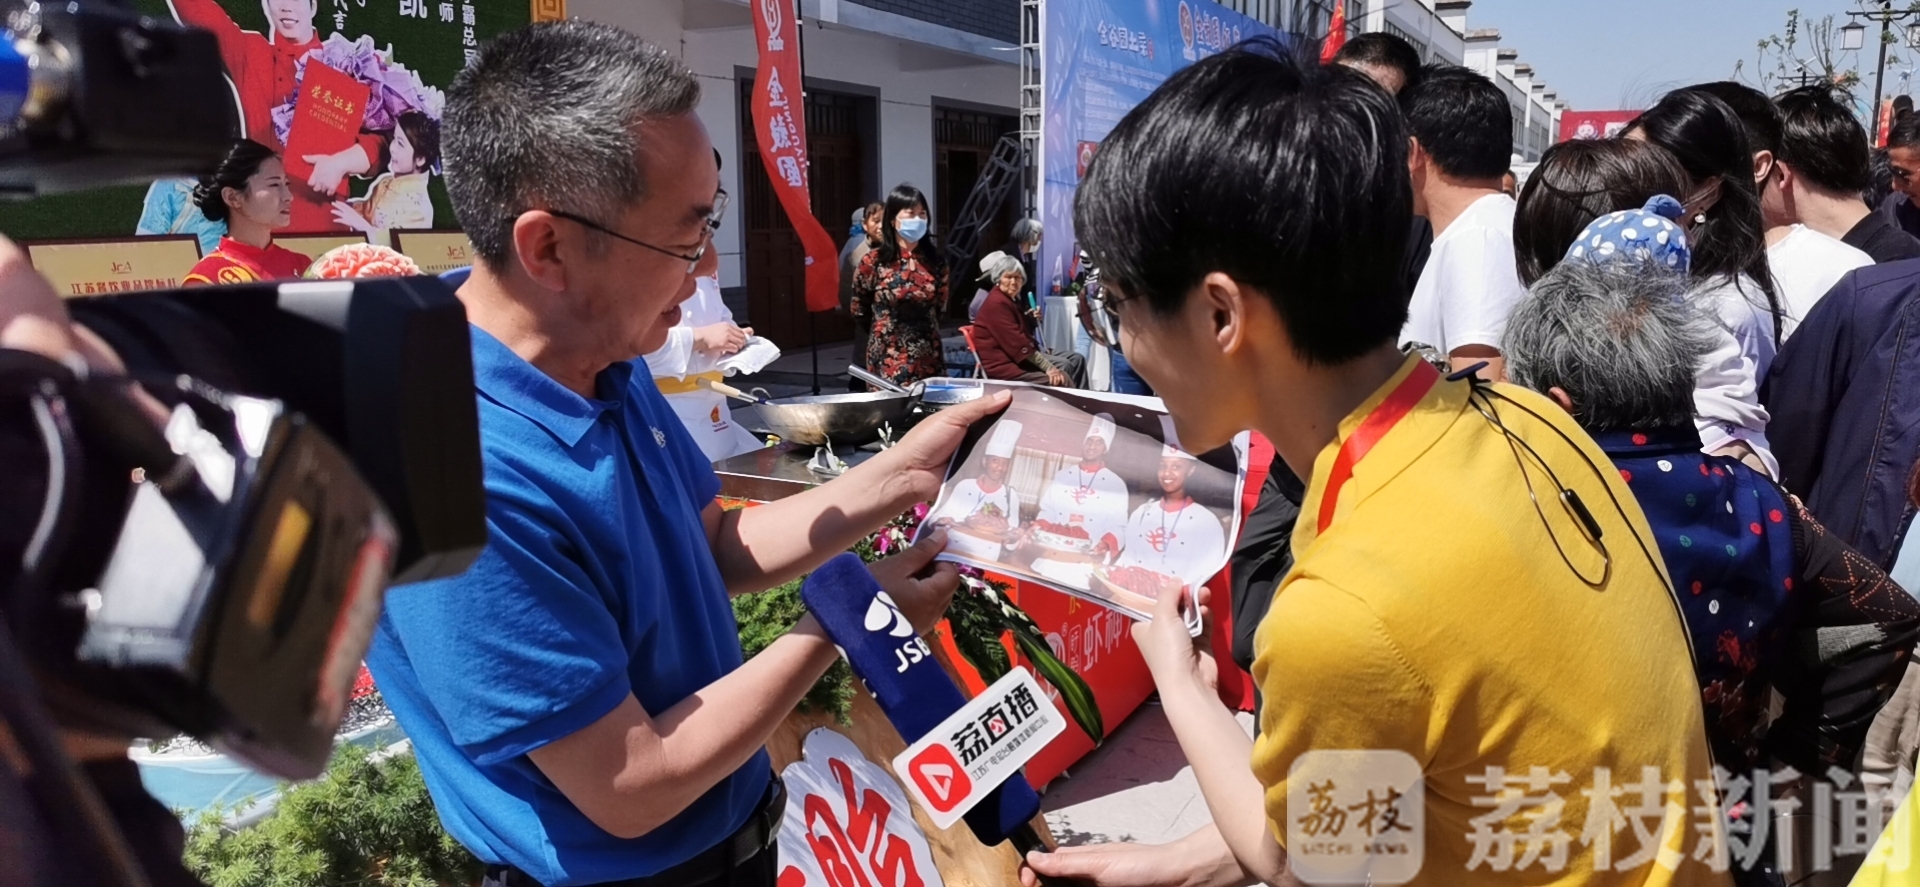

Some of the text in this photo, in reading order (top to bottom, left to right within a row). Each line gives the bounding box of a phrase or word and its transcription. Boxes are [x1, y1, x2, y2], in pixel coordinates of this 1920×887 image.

[439, 2, 454, 23] 师
[311, 85, 355, 115] 荣誉证书
[312, 103, 348, 124] HONORARY
[309, 109, 347, 133] CREDENTIAL
[1083, 607, 1131, 672] 虾神
[950, 681, 1039, 767] 荔直播
